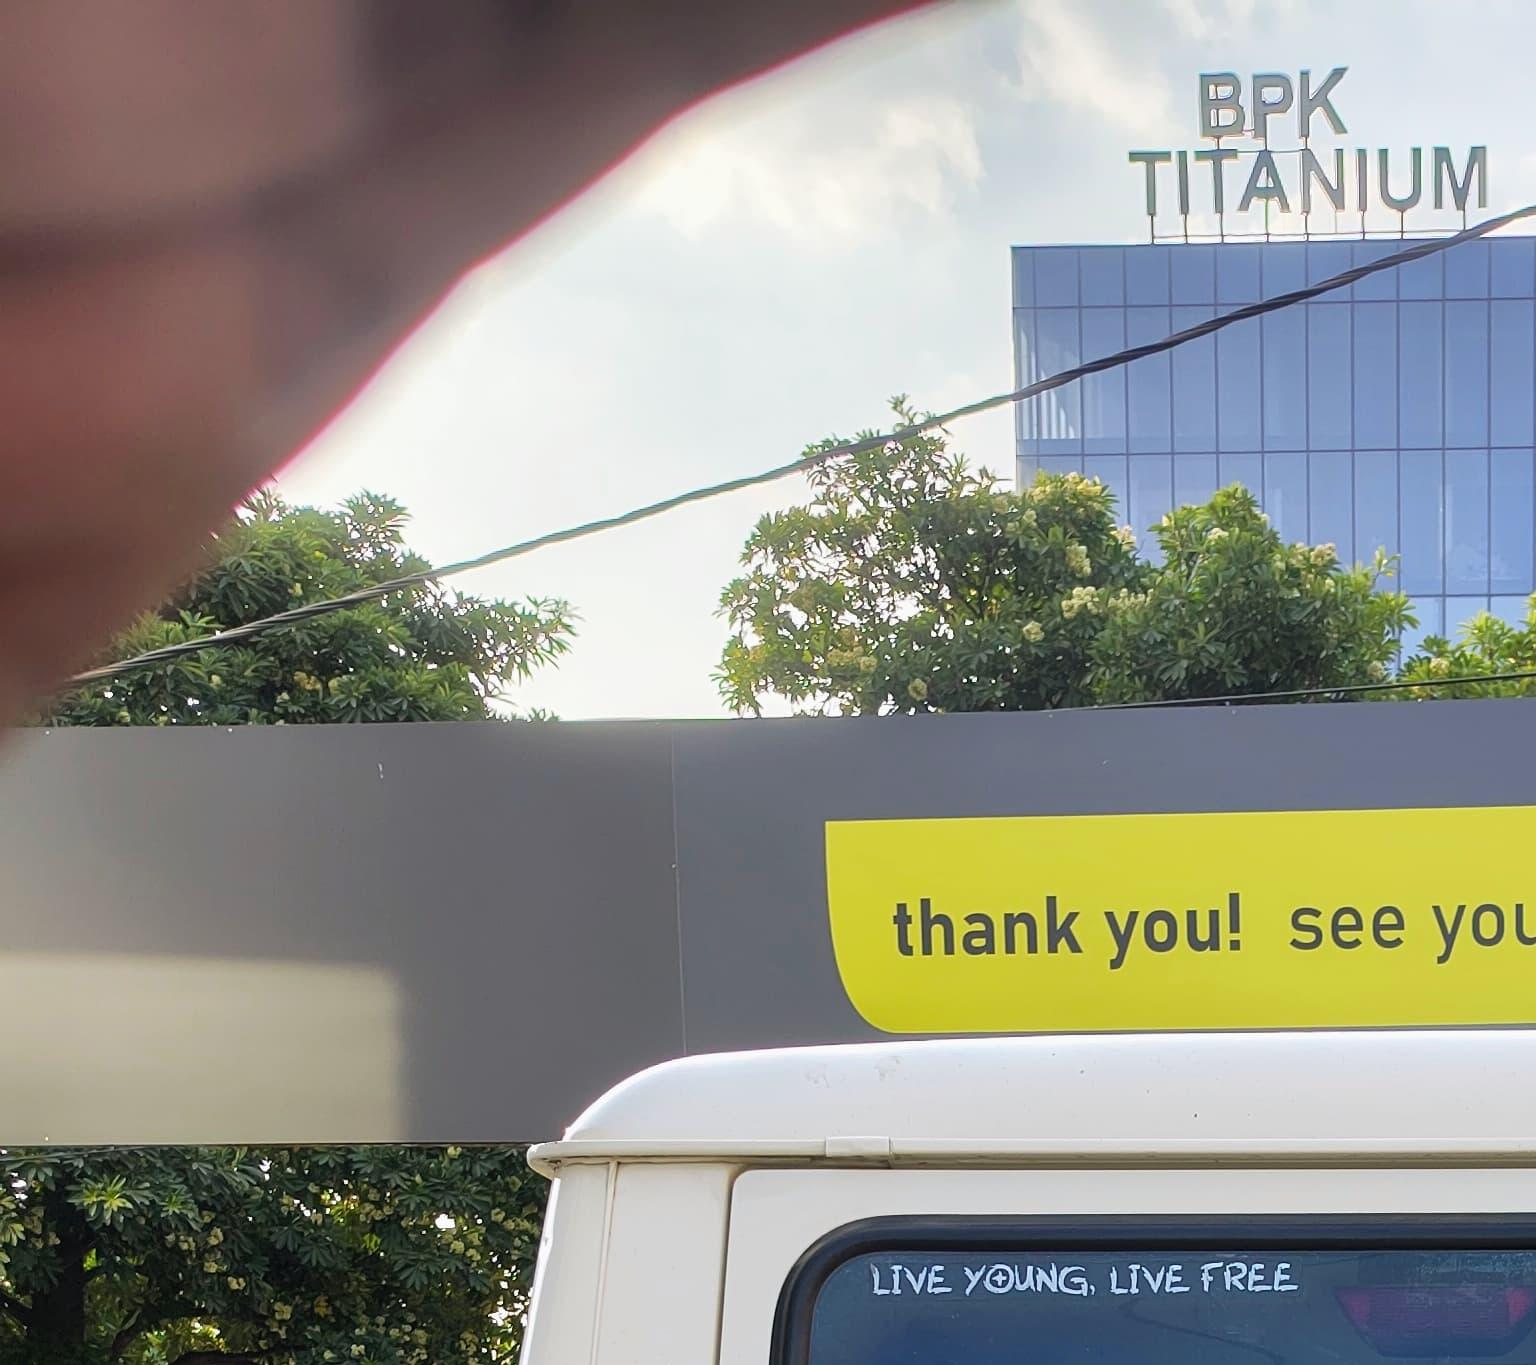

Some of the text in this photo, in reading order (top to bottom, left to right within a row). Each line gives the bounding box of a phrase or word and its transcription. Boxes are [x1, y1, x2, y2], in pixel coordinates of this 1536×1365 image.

[1199, 67, 1348, 138] BPK
[1128, 145, 1487, 217] TITANIUM
[893, 896, 1084, 958] thank
[1104, 893, 1242, 971] you!
[1291, 906, 1406, 952] see
[872, 1262, 1300, 1298] LIVE YOUNG, LIVE FREE
